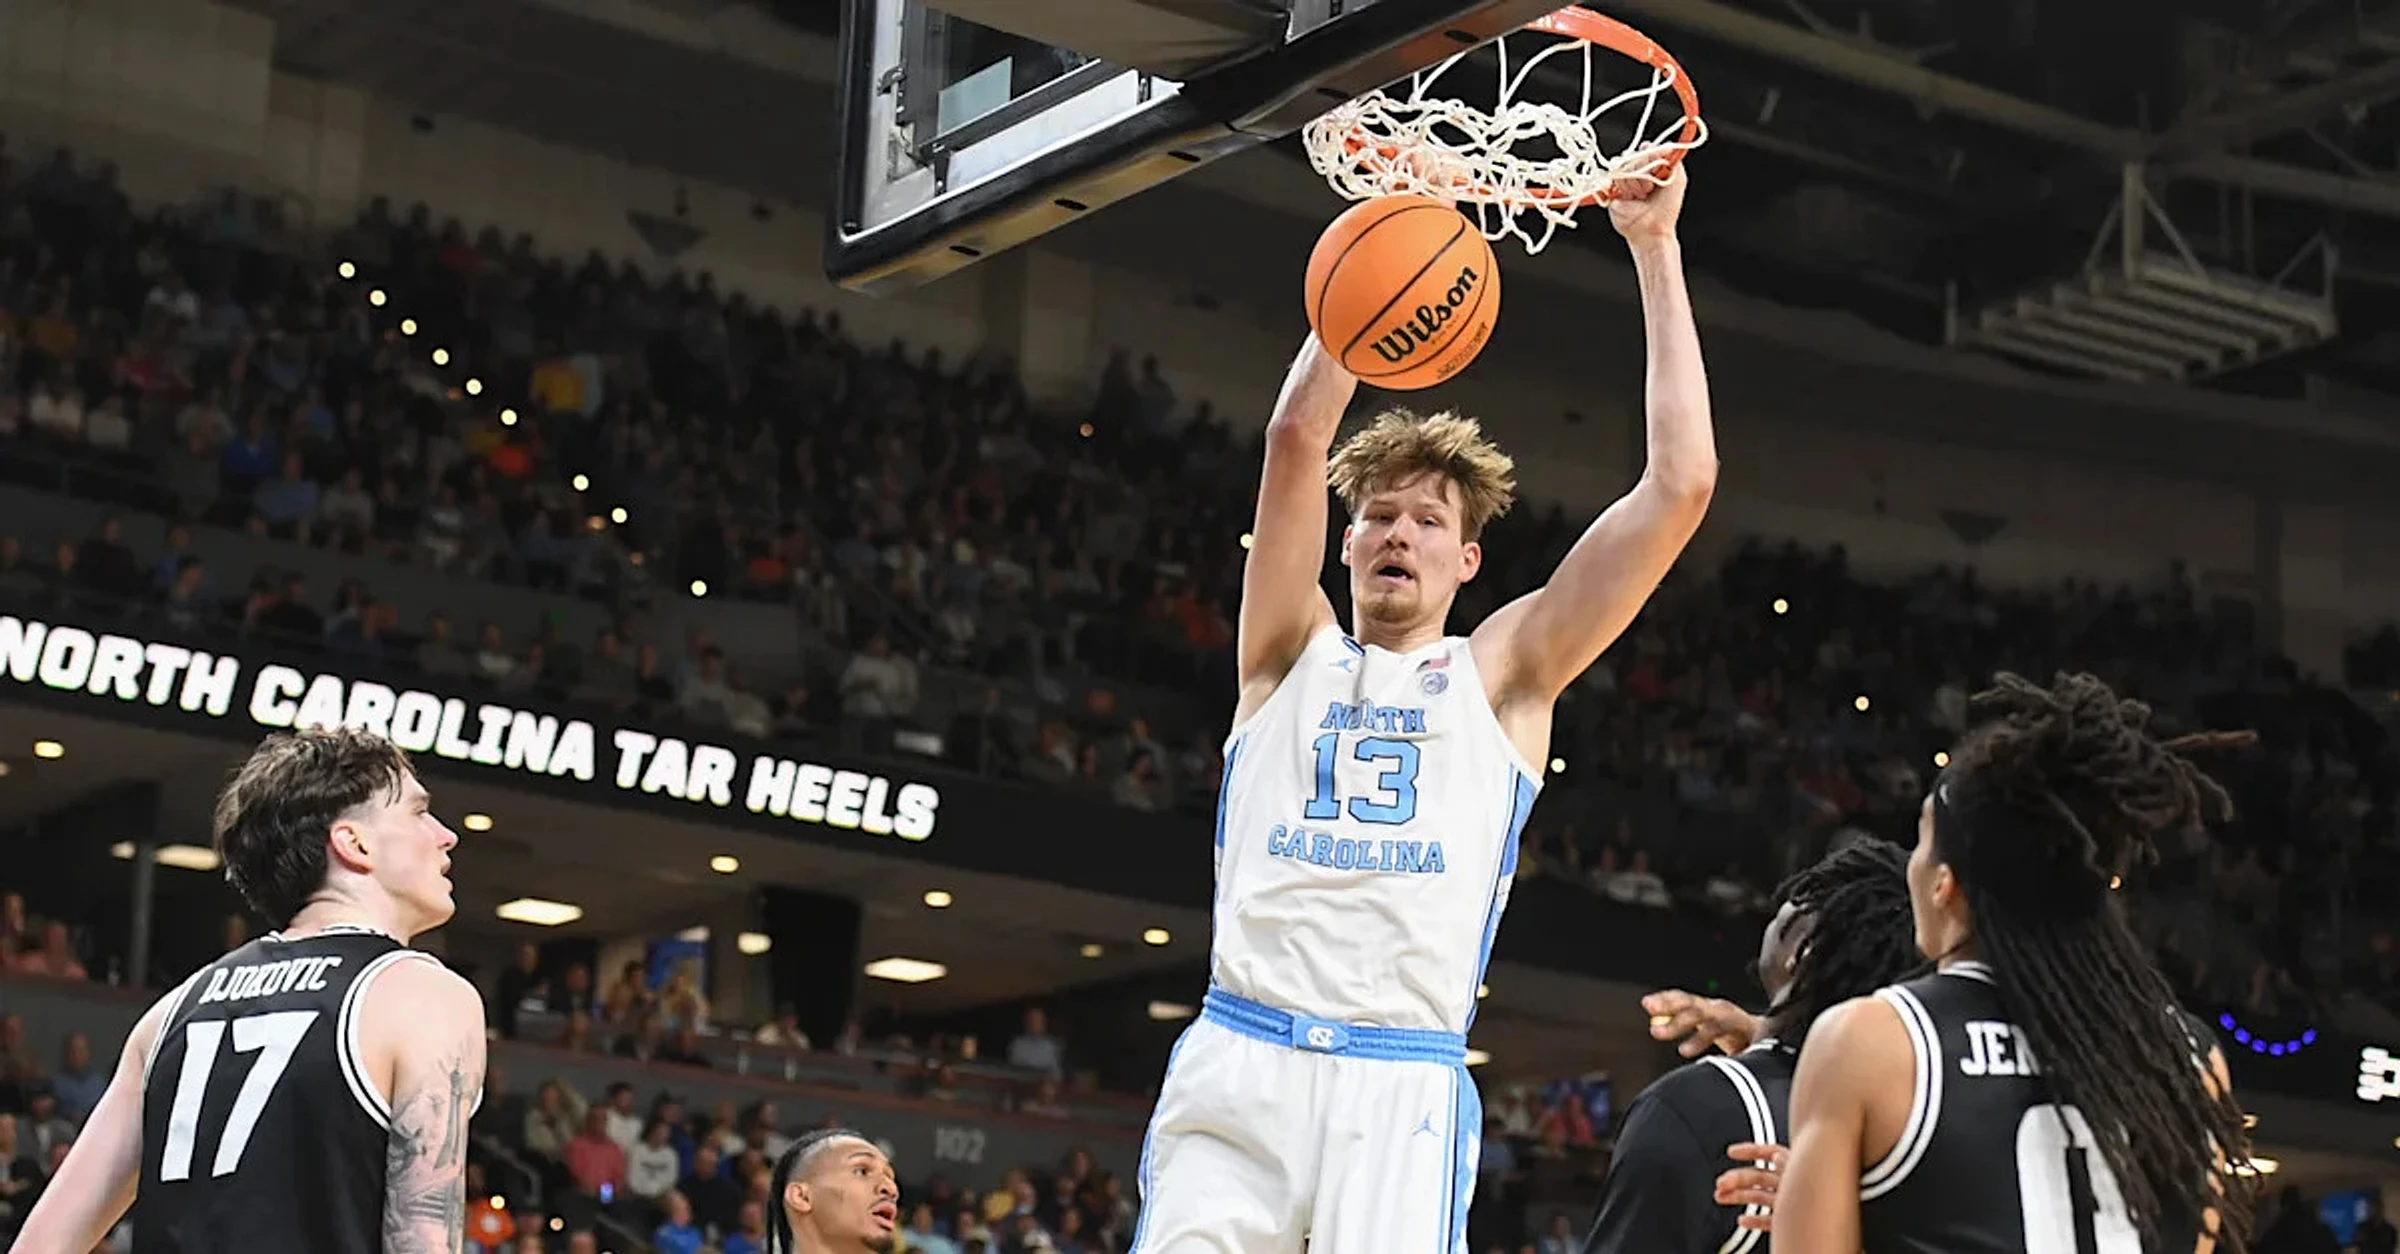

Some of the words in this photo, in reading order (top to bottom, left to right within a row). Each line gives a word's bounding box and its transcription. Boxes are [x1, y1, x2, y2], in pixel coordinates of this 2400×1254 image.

[1370, 266, 1478, 362] Wilson
[0, 615, 240, 717] NORTH
[249, 664, 596, 782] CAROLINA
[613, 728, 737, 807] TAR
[745, 755, 939, 841] HEELS
[1304, 732, 1421, 826] 13
[1267, 824, 1446, 873] CAROLINA
[199, 956, 343, 1004] DJOKOVIC
[160, 1010, 320, 1182] 17
